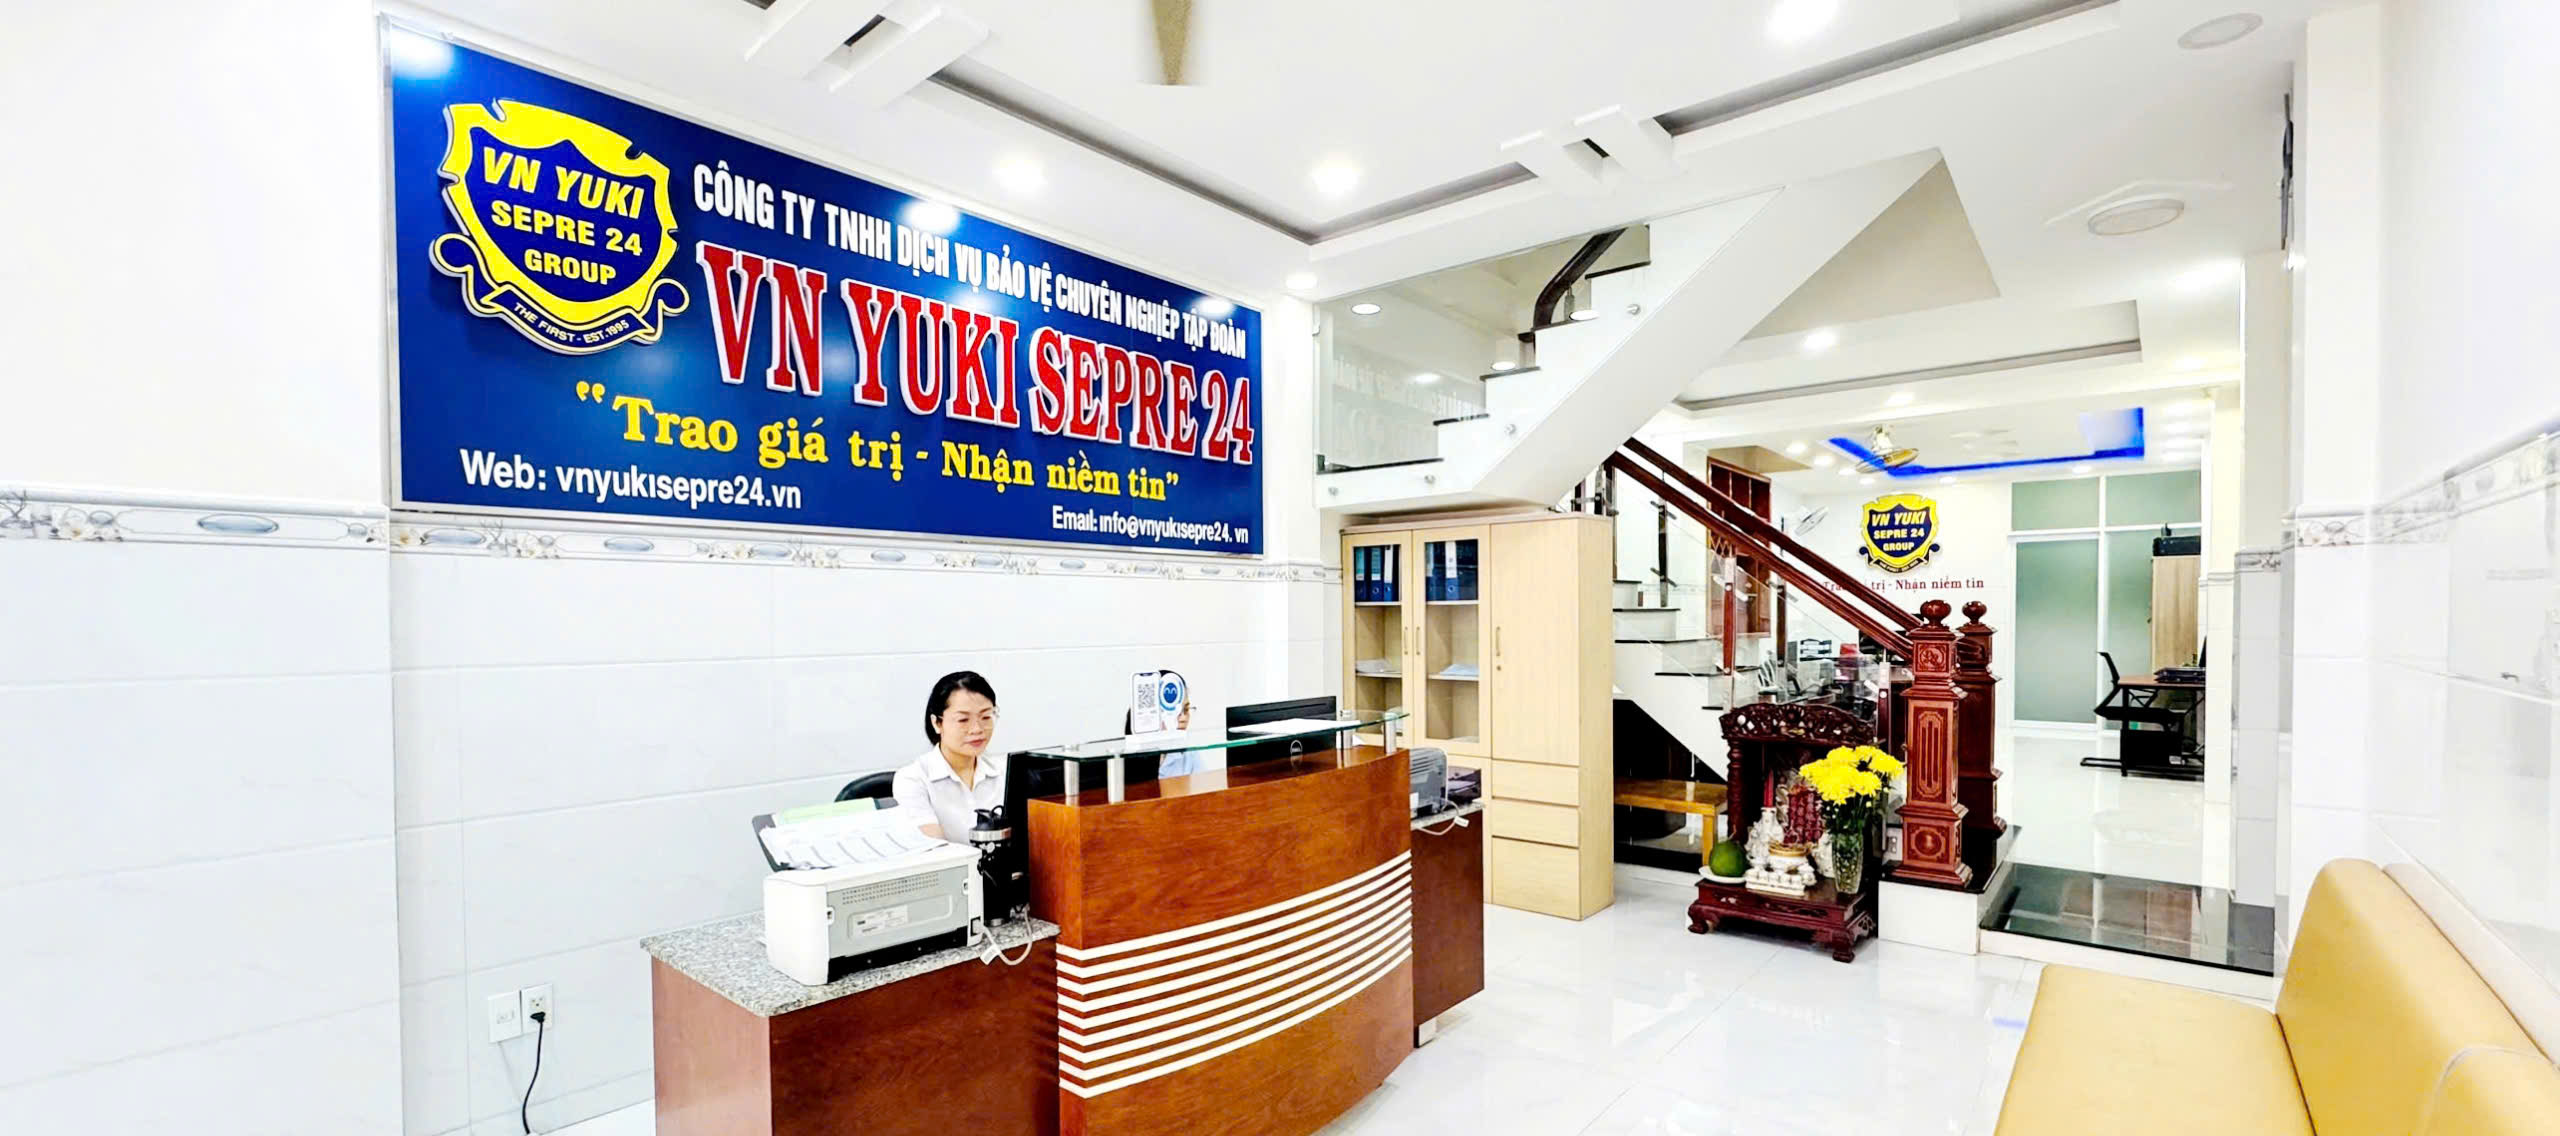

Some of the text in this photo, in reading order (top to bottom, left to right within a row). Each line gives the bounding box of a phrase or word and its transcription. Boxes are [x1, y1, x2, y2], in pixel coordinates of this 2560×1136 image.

[483, 146, 645, 219] VN YUKI
[491, 200, 643, 256] SEPRE 24
[524, 249, 617, 285] GROUP
[693, 160, 1246, 360] CÔNG TY TNHH DỊCH VỤ BẢO VỆ CHUYÊN NGHIỆP TẬP ĐOÀN
[514, 302, 539, 324] THE
[538, 320, 576, 343] FIRST
[583, 319, 630, 344] EST.1995
[695, 240, 827, 396] VN
[841, 278, 1020, 427] YUKI
[1028, 326, 1199, 458] SEPRE
[1201, 370, 1255, 465] 24
[460, 449, 547, 491] Web:
[758, 417, 829, 469] giá
[848, 431, 904, 481] trị
[915, 451, 929, 460] -
[941, 440, 1035, 493] Nhận
[1047, 450, 1121, 496] niềm
[1871, 511, 1927, 527] VN YUKI
[1873, 527, 1925, 539] SEPRE 24
[1882, 542, 1915, 551] GROUP
[1966, 577, 1984, 589] tin
